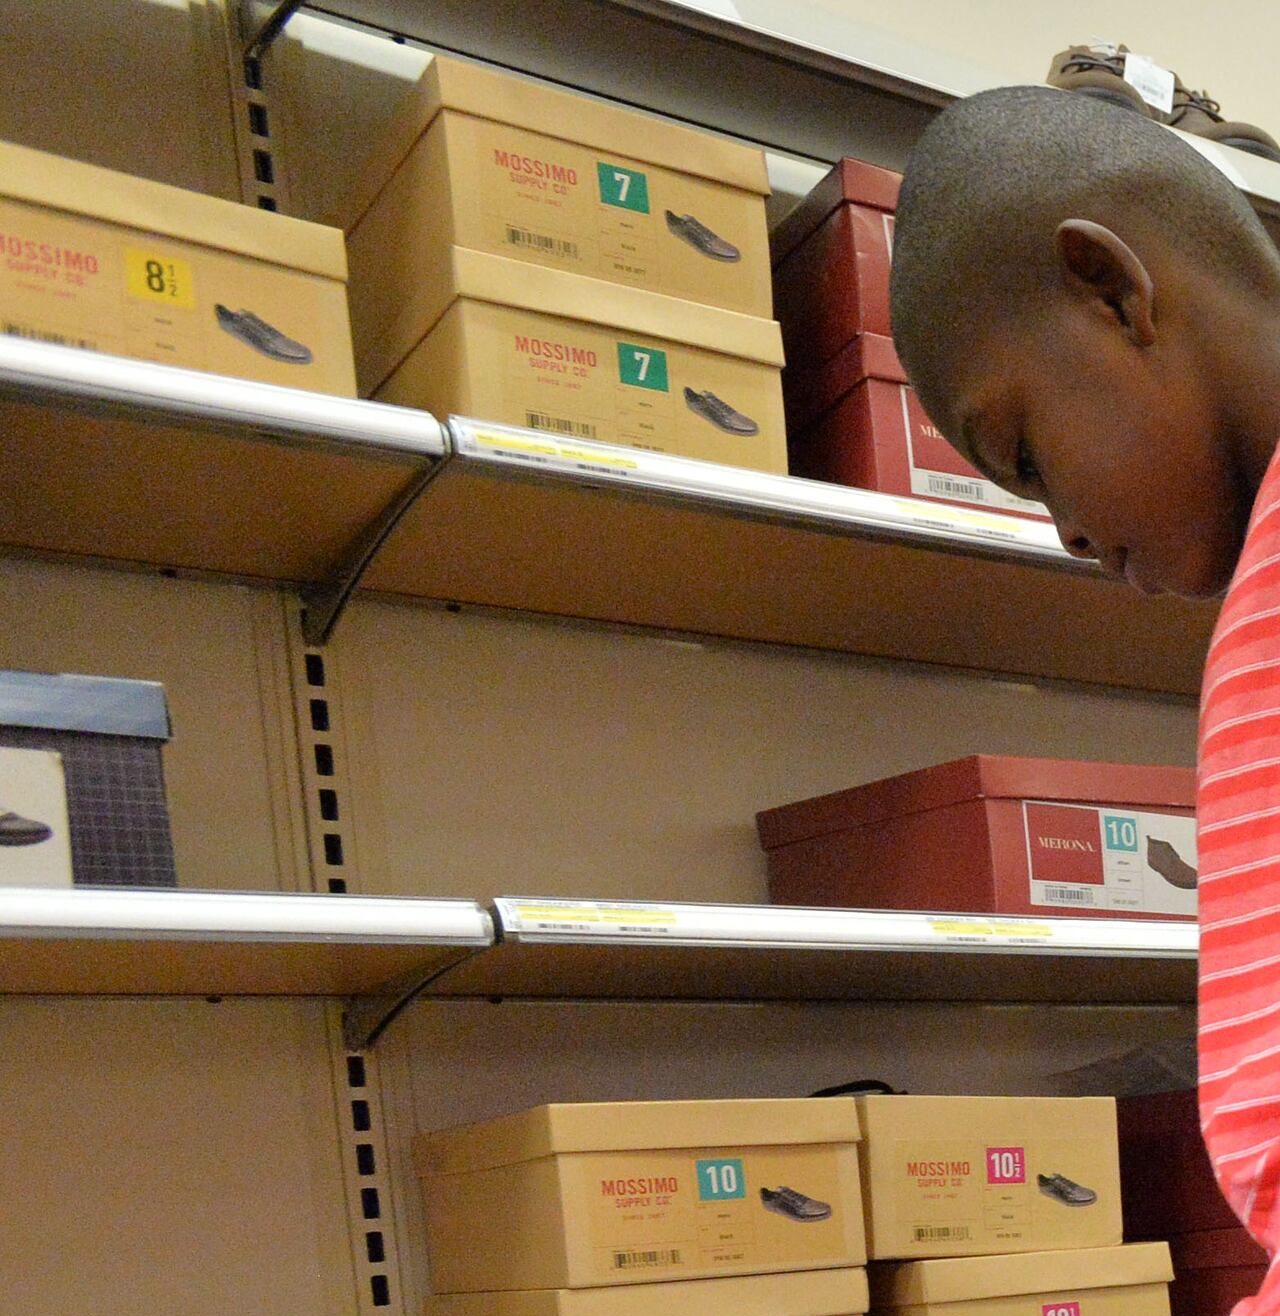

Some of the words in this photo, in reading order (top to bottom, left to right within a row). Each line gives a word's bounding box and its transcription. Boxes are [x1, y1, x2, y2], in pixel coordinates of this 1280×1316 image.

[494, 150, 578, 185] MOSSIMO
[613, 172, 631, 202] 7
[146, 260, 165, 293] 8
[515, 335, 597, 368] MOSSIMO
[634, 352, 650, 381] 7
[1038, 836, 1095, 852] MERONA
[1107, 821, 1136, 847] 10
[706, 1165, 737, 1194] 10
[907, 1162, 970, 1176] MOSSIMO
[991, 1153, 1014, 1178] 10
[602, 1177, 678, 1196] MOSSIMO
